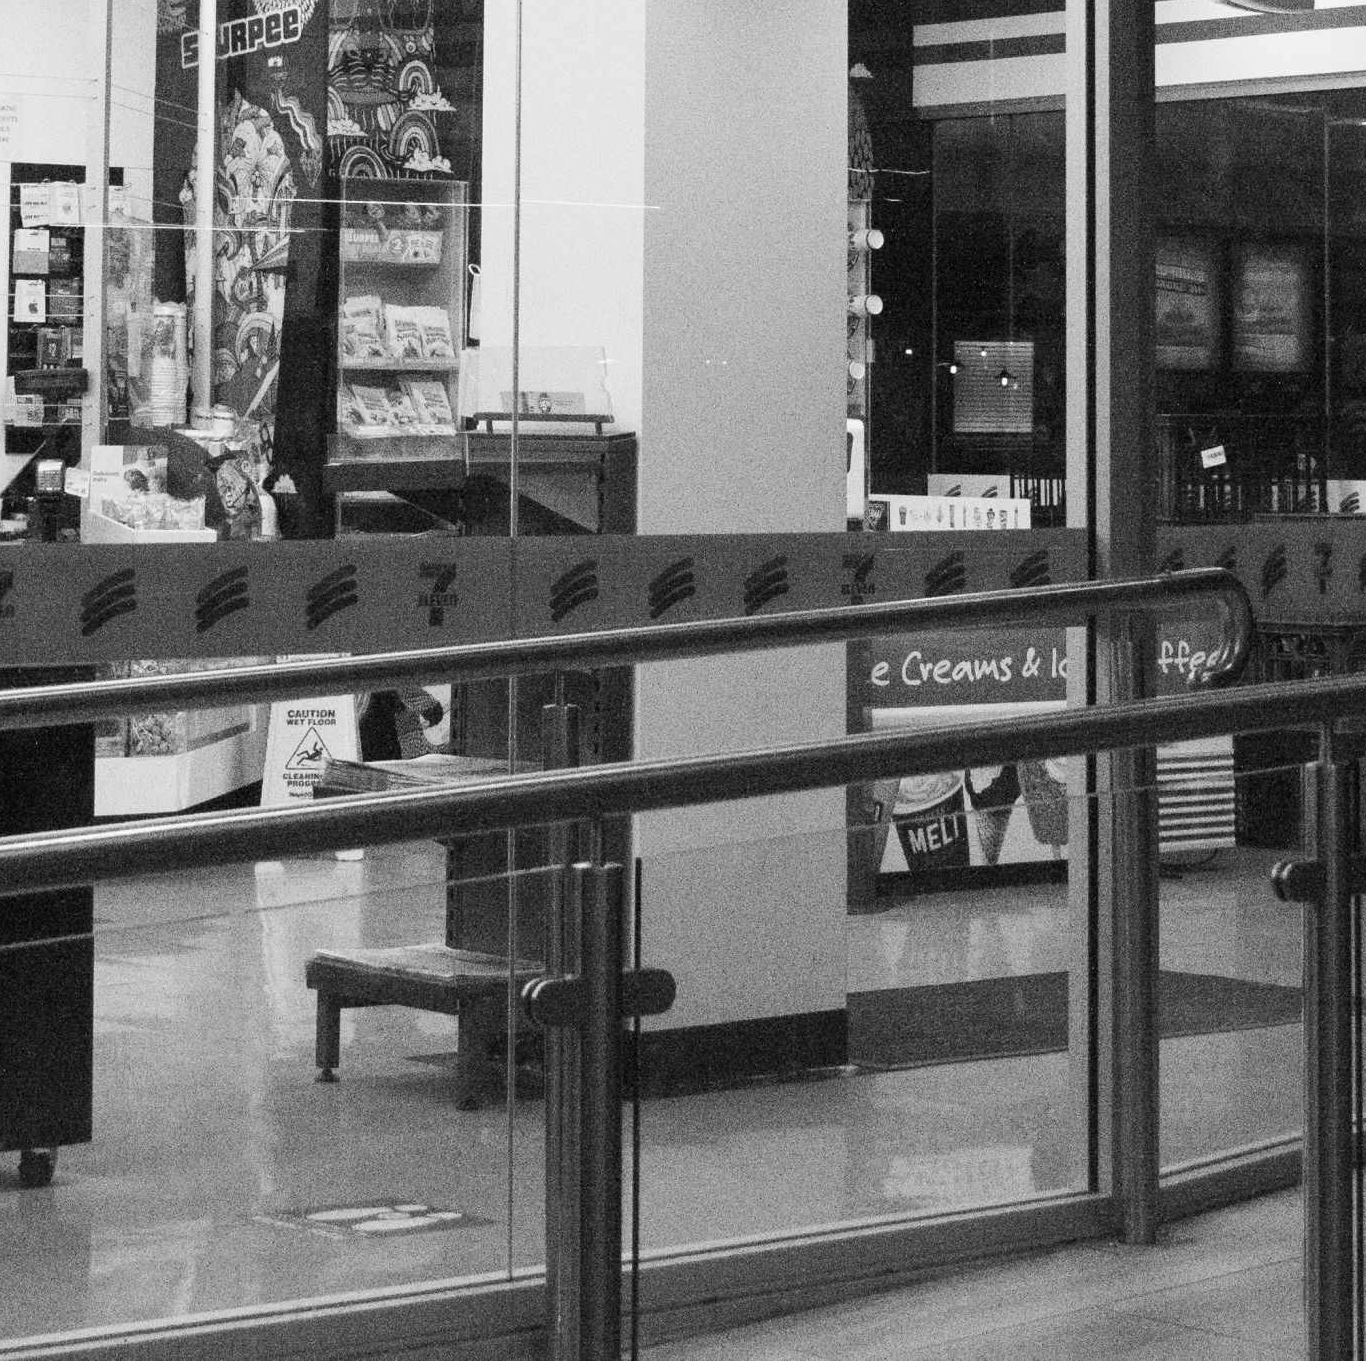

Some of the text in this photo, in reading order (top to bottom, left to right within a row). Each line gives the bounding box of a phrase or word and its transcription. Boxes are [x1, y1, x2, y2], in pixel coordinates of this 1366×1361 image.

[901, 650, 1013, 685] Creams
[1022, 647, 1041, 678] &
[287, 709, 336, 718] CAUTION
[286, 718, 337, 726] WET FLOOR
[282, 772, 323, 780] CLEANIN
